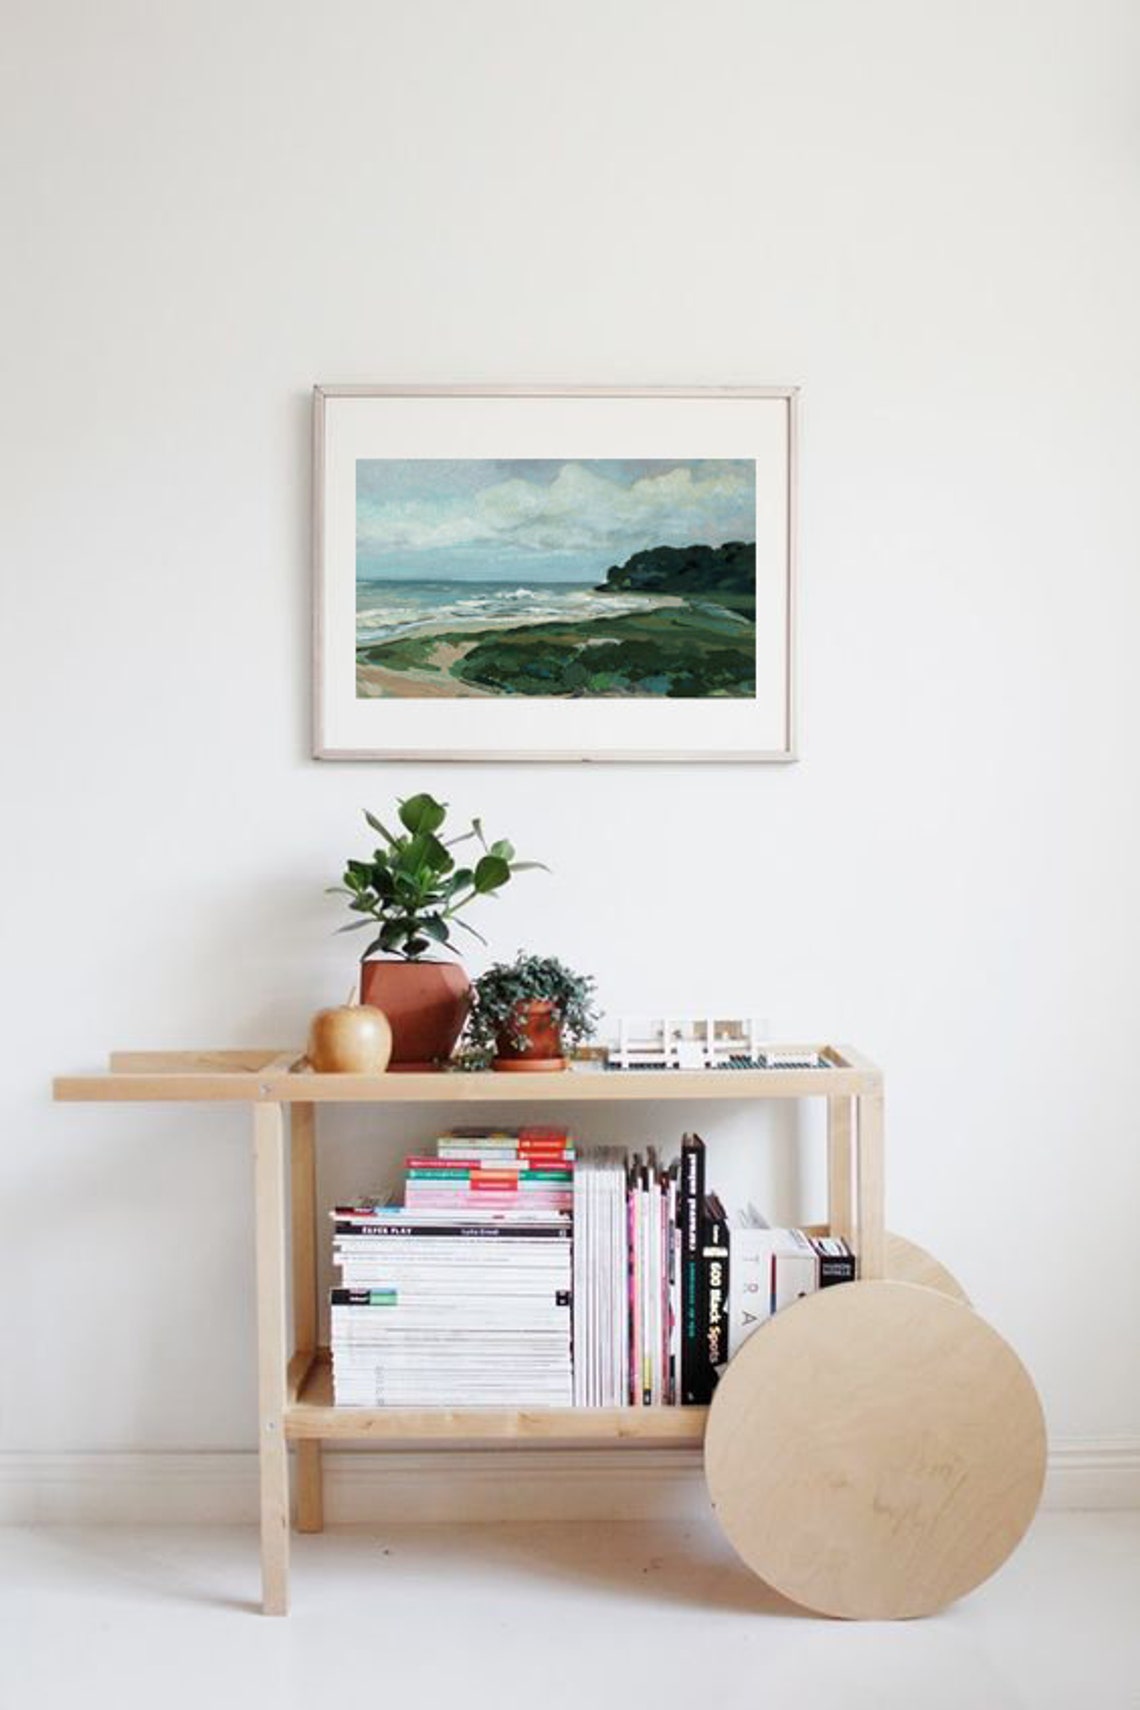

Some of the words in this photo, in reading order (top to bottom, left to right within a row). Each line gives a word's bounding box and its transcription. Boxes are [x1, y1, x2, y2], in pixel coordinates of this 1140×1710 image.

[709, 1262, 722, 1286] 600
[708, 1288, 722, 1324] Black
[706, 1325, 721, 1363] Spots
